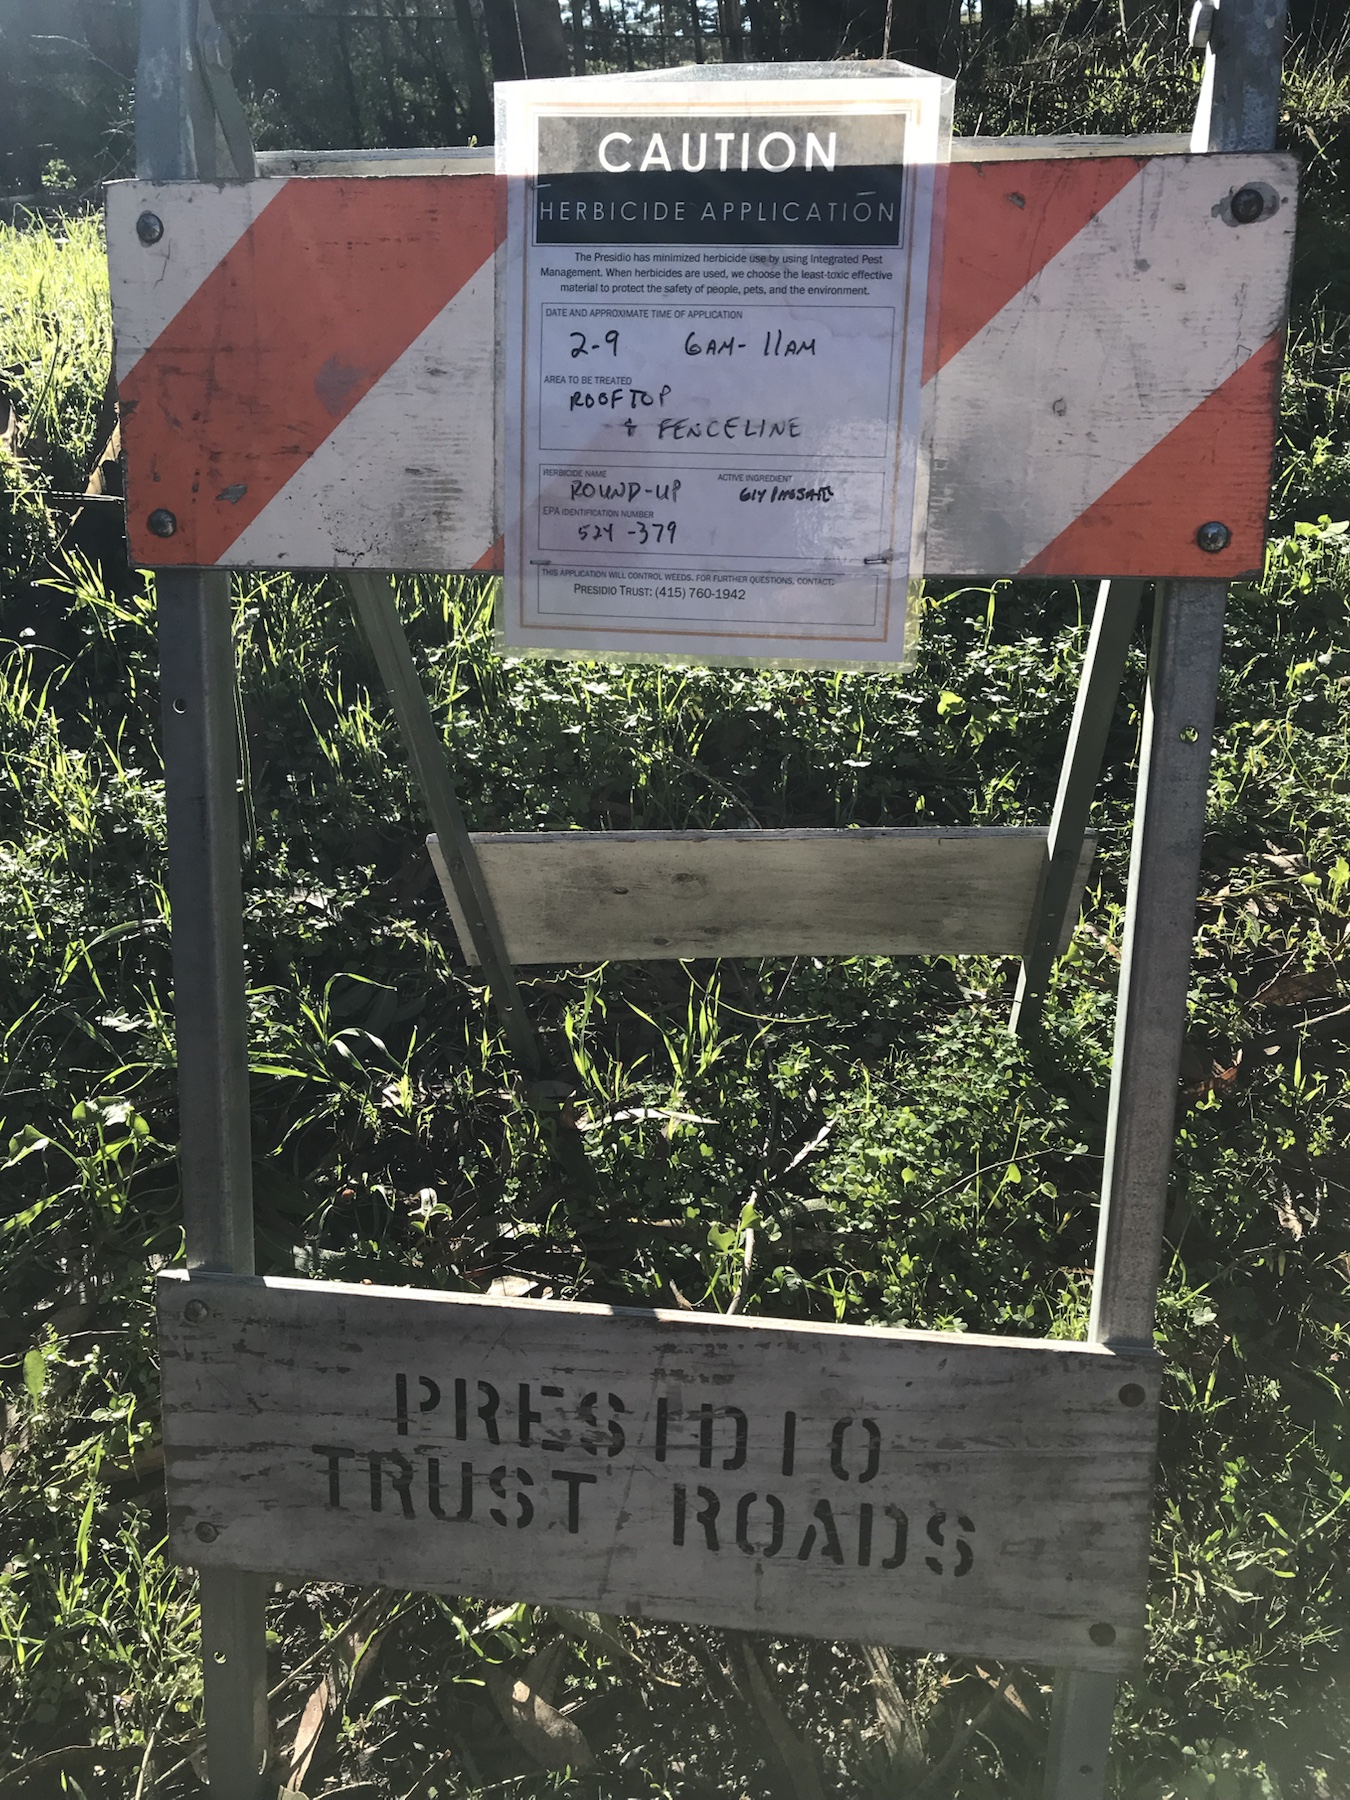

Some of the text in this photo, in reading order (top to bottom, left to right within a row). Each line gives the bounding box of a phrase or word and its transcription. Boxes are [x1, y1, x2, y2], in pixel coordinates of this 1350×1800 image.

[598, 131, 836, 173] CAUTION
[540, 201, 894, 222] HERBICIDE APPLICATION
[575, 252, 883, 265] The Presidio has minimized herbicide use by using Integrated Pest
[540, 268, 603, 278] Management.
[605, 268, 632, 277] When
[634, 268, 682, 278] herbicides
[684, 270, 700, 278] are
[703, 269, 728, 279] used,
[746, 270, 781, 279] choose
[783, 270, 799, 279] the
[801, 270, 849, 280] least-toxic
[851, 270, 893, 280] effective
[560, 283, 870, 296] material to protect the safety of people, pets, and the environment.
[546, 308, 743, 319] DATE AND APPROXIMATE TIME OF APPLICATION
[570, 329, 620, 358] 2-9
[764, 329, 816, 357] 11AM
[544, 376, 632, 385] AREA TO BE TREATED
[570, 385, 671, 411] ROOFTOP
[658, 416, 801, 440] FENCELINE
[543, 468, 607, 478] HERBICIDE NAME
[717, 474, 792, 482] ACTIVE INGREDIENT
[571, 479, 681, 503] ROUND-UP
[543, 506, 560, 515] EPA
[562, 508, 619, 517] IDENTIFICATION
[560, 569, 607, 578] APPLICATION
[608, 571, 626, 579] WILL
[628, 572, 663, 580] CONTROL
[695, 574, 712, 582] FOR
[713, 575, 748, 583] FURTHER
[749, 576, 795, 585] QUESTIONS,
[797, 578, 835, 586] CONTACT:
[574, 583, 746, 600] PRESIDIO TRUST: (415) 760-1942
[395, 1372, 882, 1483] PRESIDIO
[312, 1443, 976, 1578] TRUST ROADS
